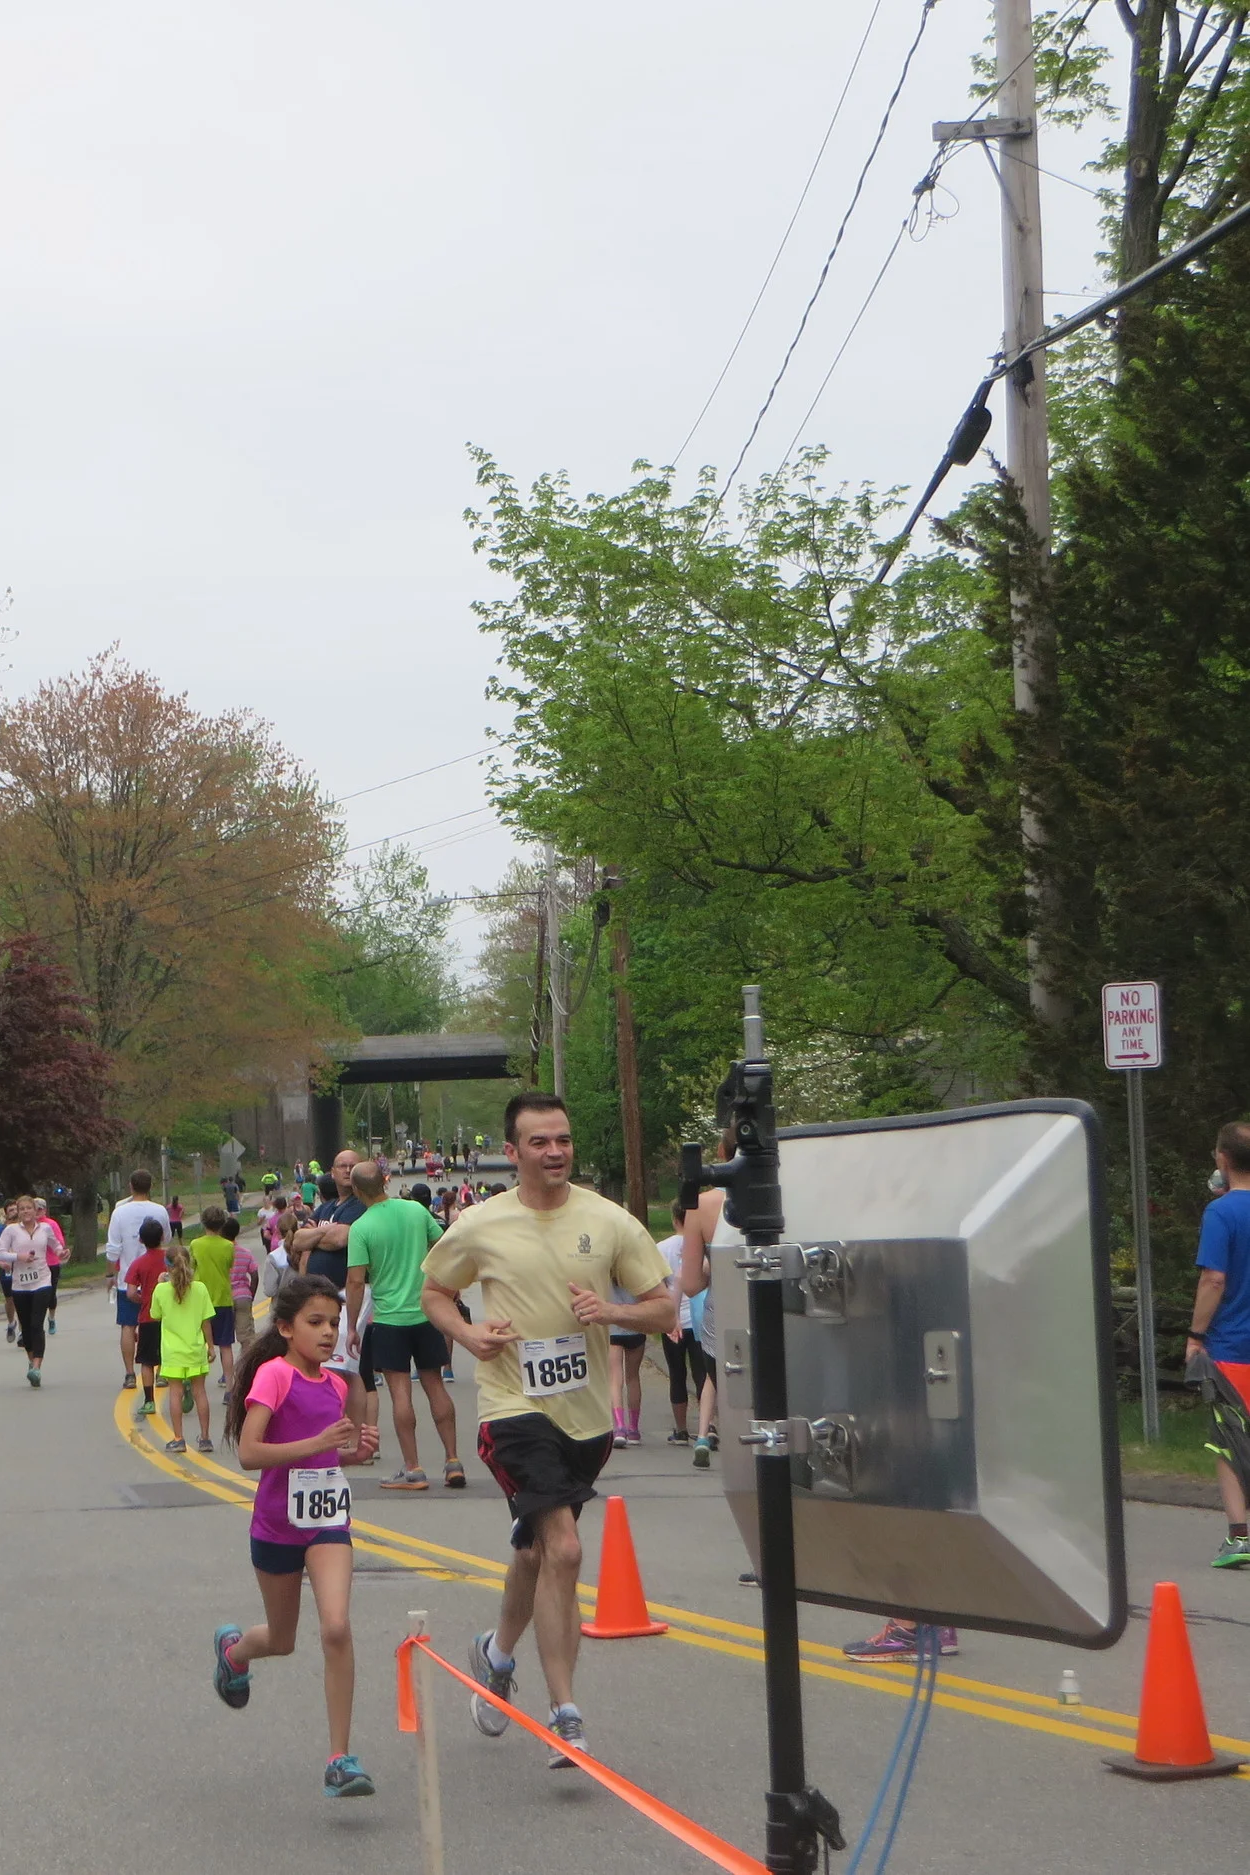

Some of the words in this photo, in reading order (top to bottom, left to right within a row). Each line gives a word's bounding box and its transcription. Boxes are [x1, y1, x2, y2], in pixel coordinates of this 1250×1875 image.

[1120, 990, 1141, 1006] NO
[1107, 1008, 1155, 1026] PARKING
[1121, 1026, 1142, 1038] ANY
[1121, 1038, 1144, 1050] TIME
[19, 1271, 39, 1282] 2118
[523, 1351, 587, 1388] 1855
[292, 1487, 351, 1519] 1854
